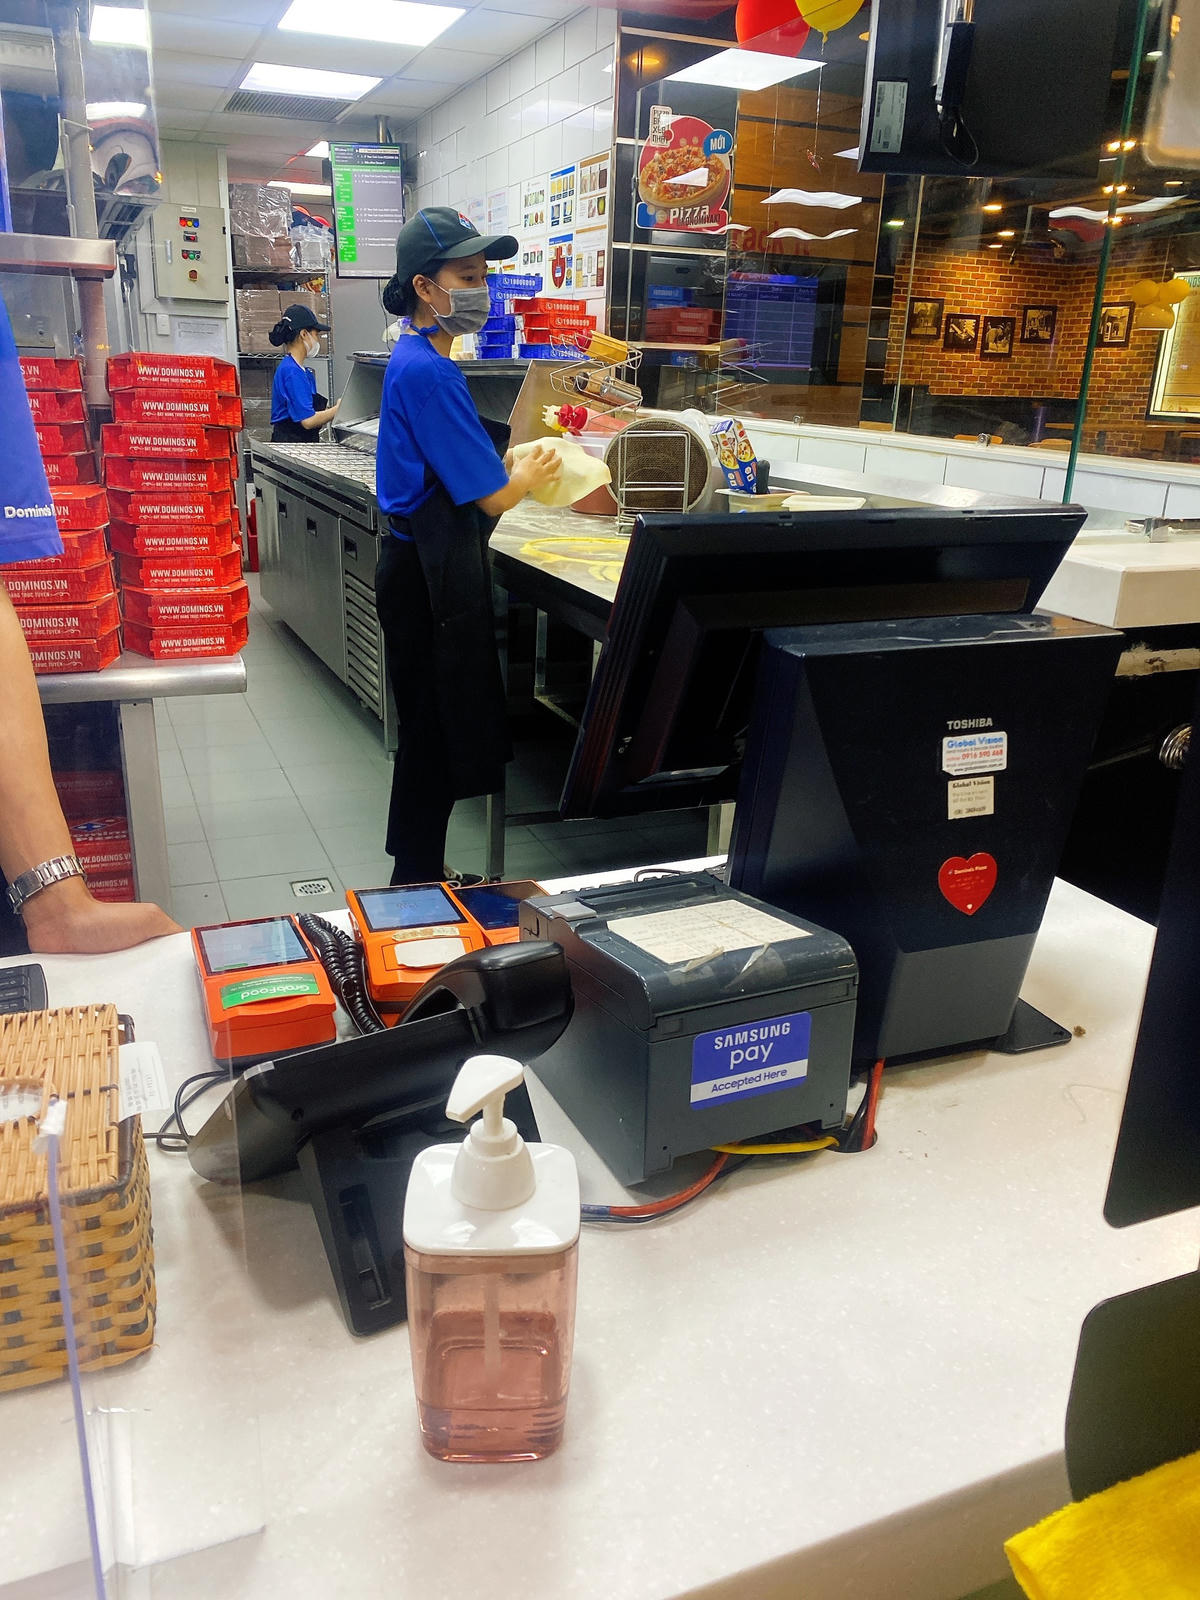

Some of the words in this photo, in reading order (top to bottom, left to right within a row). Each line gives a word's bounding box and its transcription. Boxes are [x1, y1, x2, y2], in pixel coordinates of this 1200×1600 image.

[710, 134, 726, 151] MỚI
[669, 204, 709, 224] Pizza
[138, 366, 205, 378] WWW.DOMINOS.VN
[142, 401, 209, 412] WWW.DOMINOS.VN
[129, 435, 197, 447] WWW.DOMINOS.VN
[142, 471, 207, 481] WWW.DOMINOS.VN
[139, 505, 204, 514] WWW.DOMINOS.VN
[144, 537, 208, 546] WWW.DOMINOS.VN
[150, 568, 214, 577] WWW.DOMINOS.VN
[7, 579, 68, 590] .DOMINOS.VN
[158, 604, 224, 614] WWW.DOMINOS.VN
[21, 617, 79, 628] DOMINOS.VN
[160, 637, 225, 646] WWW.DOMINOS.VN
[947, 717, 993, 730] TOSHIBA
[947, 739, 977, 749] Global
[978, 736, 1004, 745] Vision
[87, 879, 129, 888] DOMINOS.VN
[714, 1022, 791, 1050] SAMSUNG
[729, 1042, 774, 1070] pay
[711, 1073, 762, 1093] Accepted
[763, 1068, 788, 1081] Here
